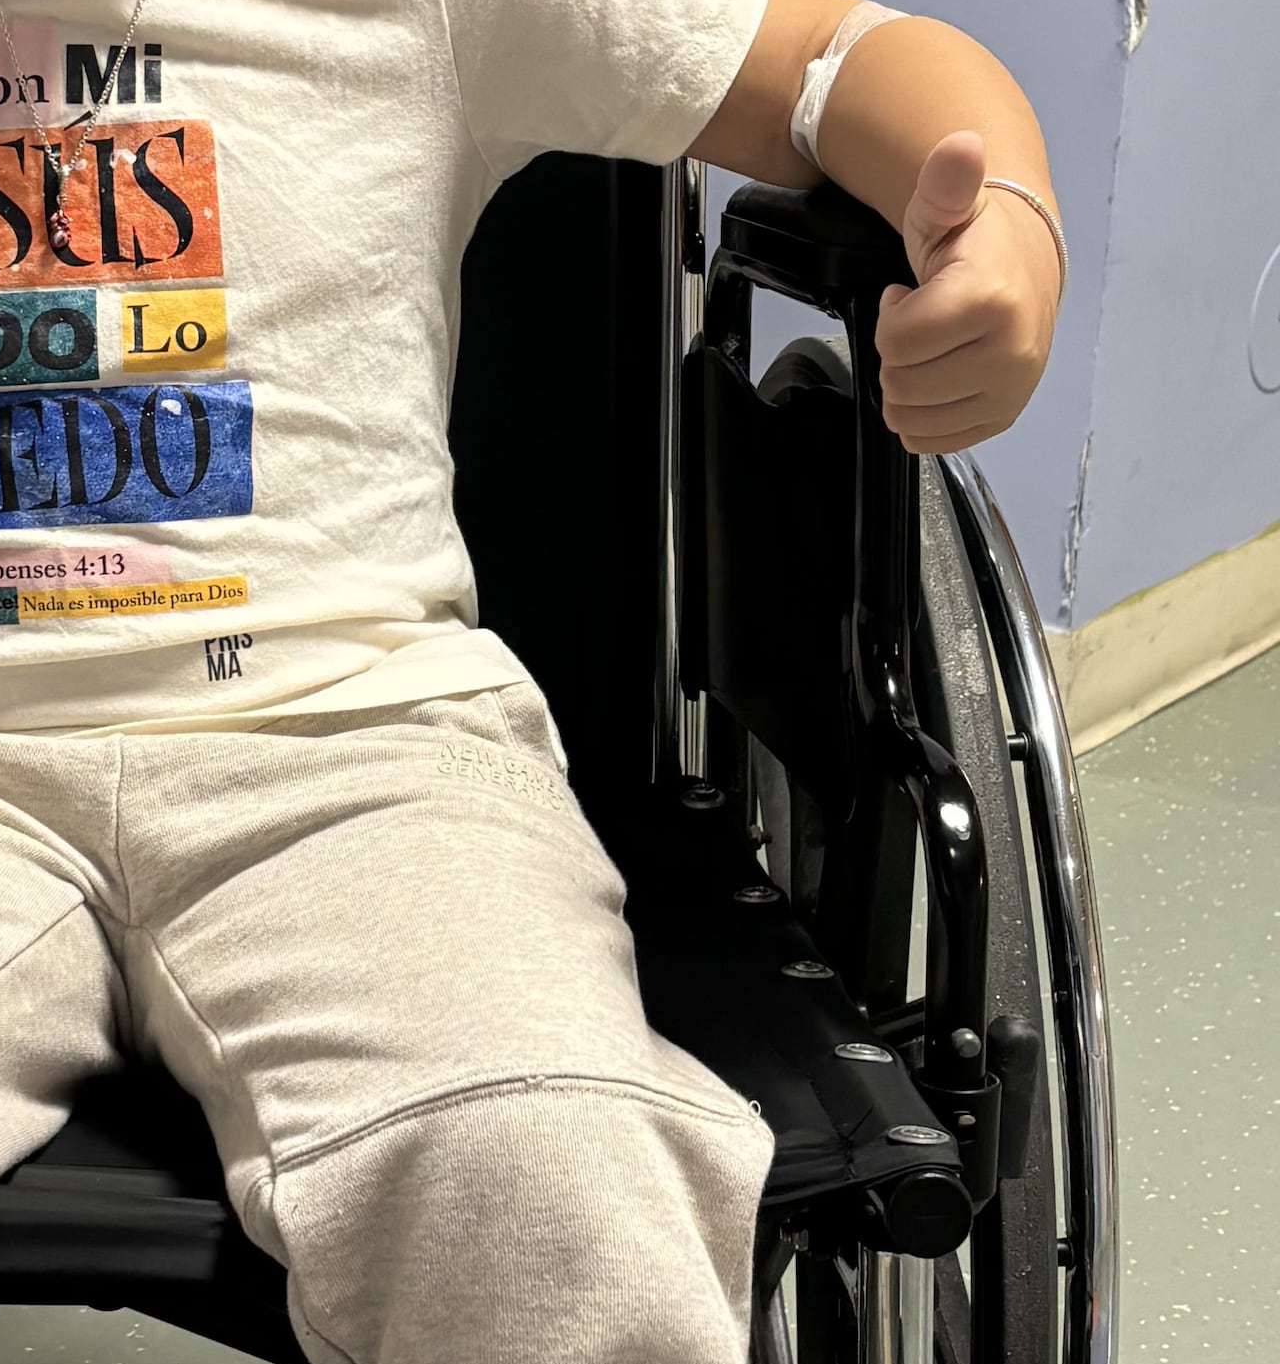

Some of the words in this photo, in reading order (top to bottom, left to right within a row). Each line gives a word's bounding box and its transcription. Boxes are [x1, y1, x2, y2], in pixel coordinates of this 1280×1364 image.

[65, 43, 162, 105] Mi
[127, 304, 208, 354] Lo
[73, 553, 126, 578] 4:13
[23, 596, 64, 611] Nada
[69, 600, 84, 610] es
[88, 590, 166, 612] imposible
[170, 594, 204, 608] para
[207, 584, 244, 601] Dios
[206, 650, 243, 682] MA
